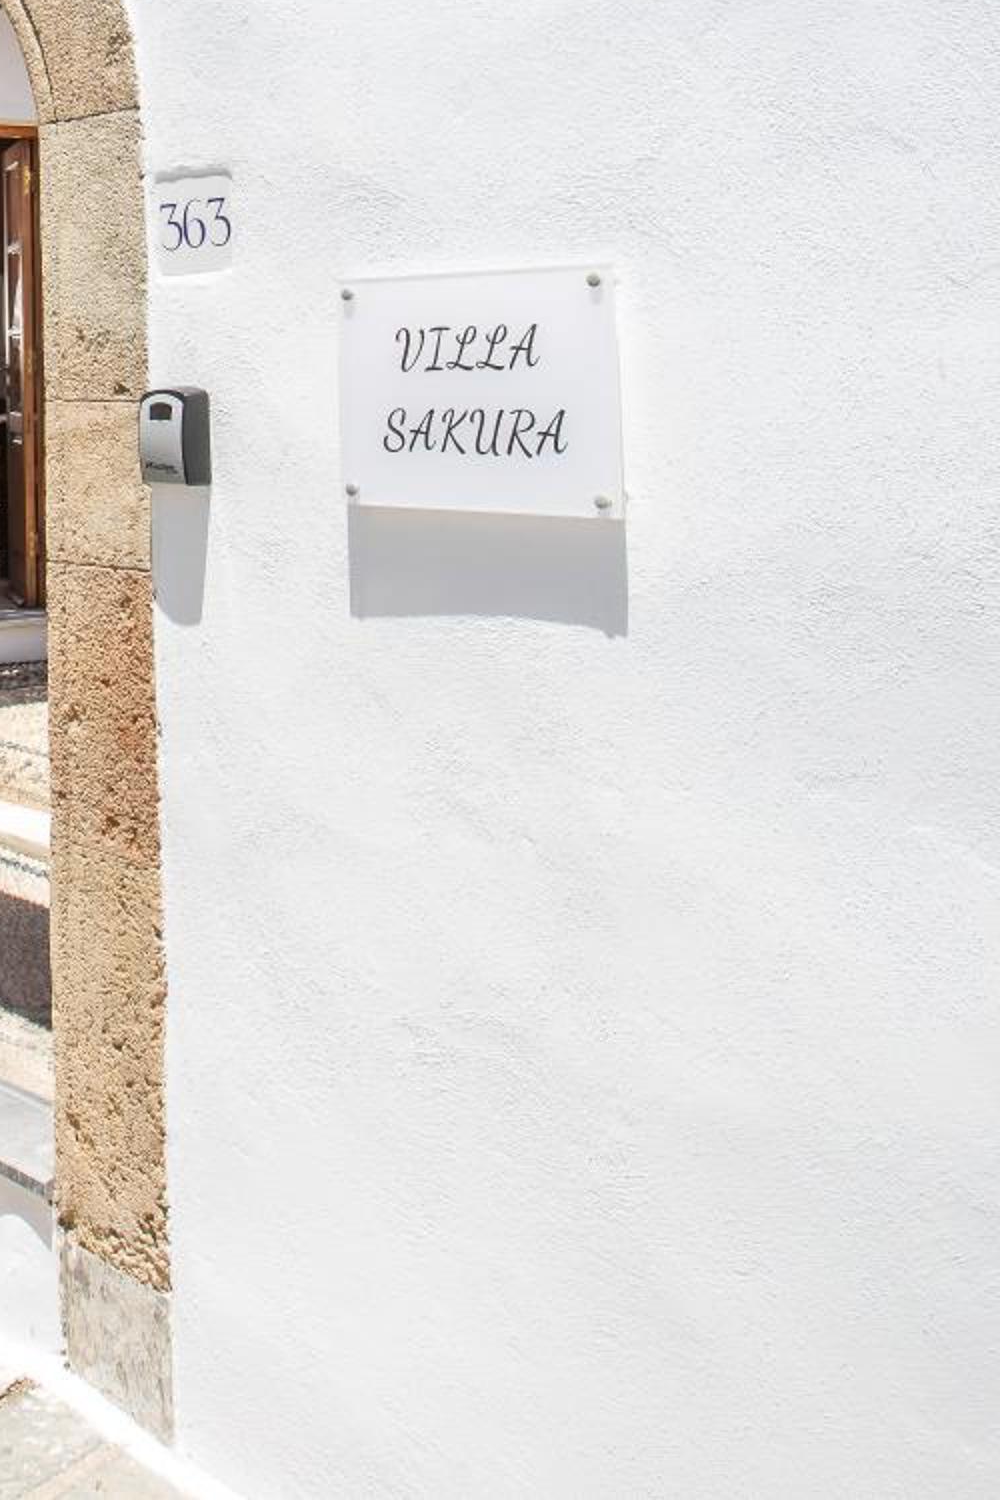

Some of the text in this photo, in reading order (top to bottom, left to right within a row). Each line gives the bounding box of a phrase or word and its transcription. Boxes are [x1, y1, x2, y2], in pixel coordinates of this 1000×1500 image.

[160, 197, 231, 252] 363
[396, 324, 540, 372] VILLA
[384, 408, 568, 458] SAKURA
